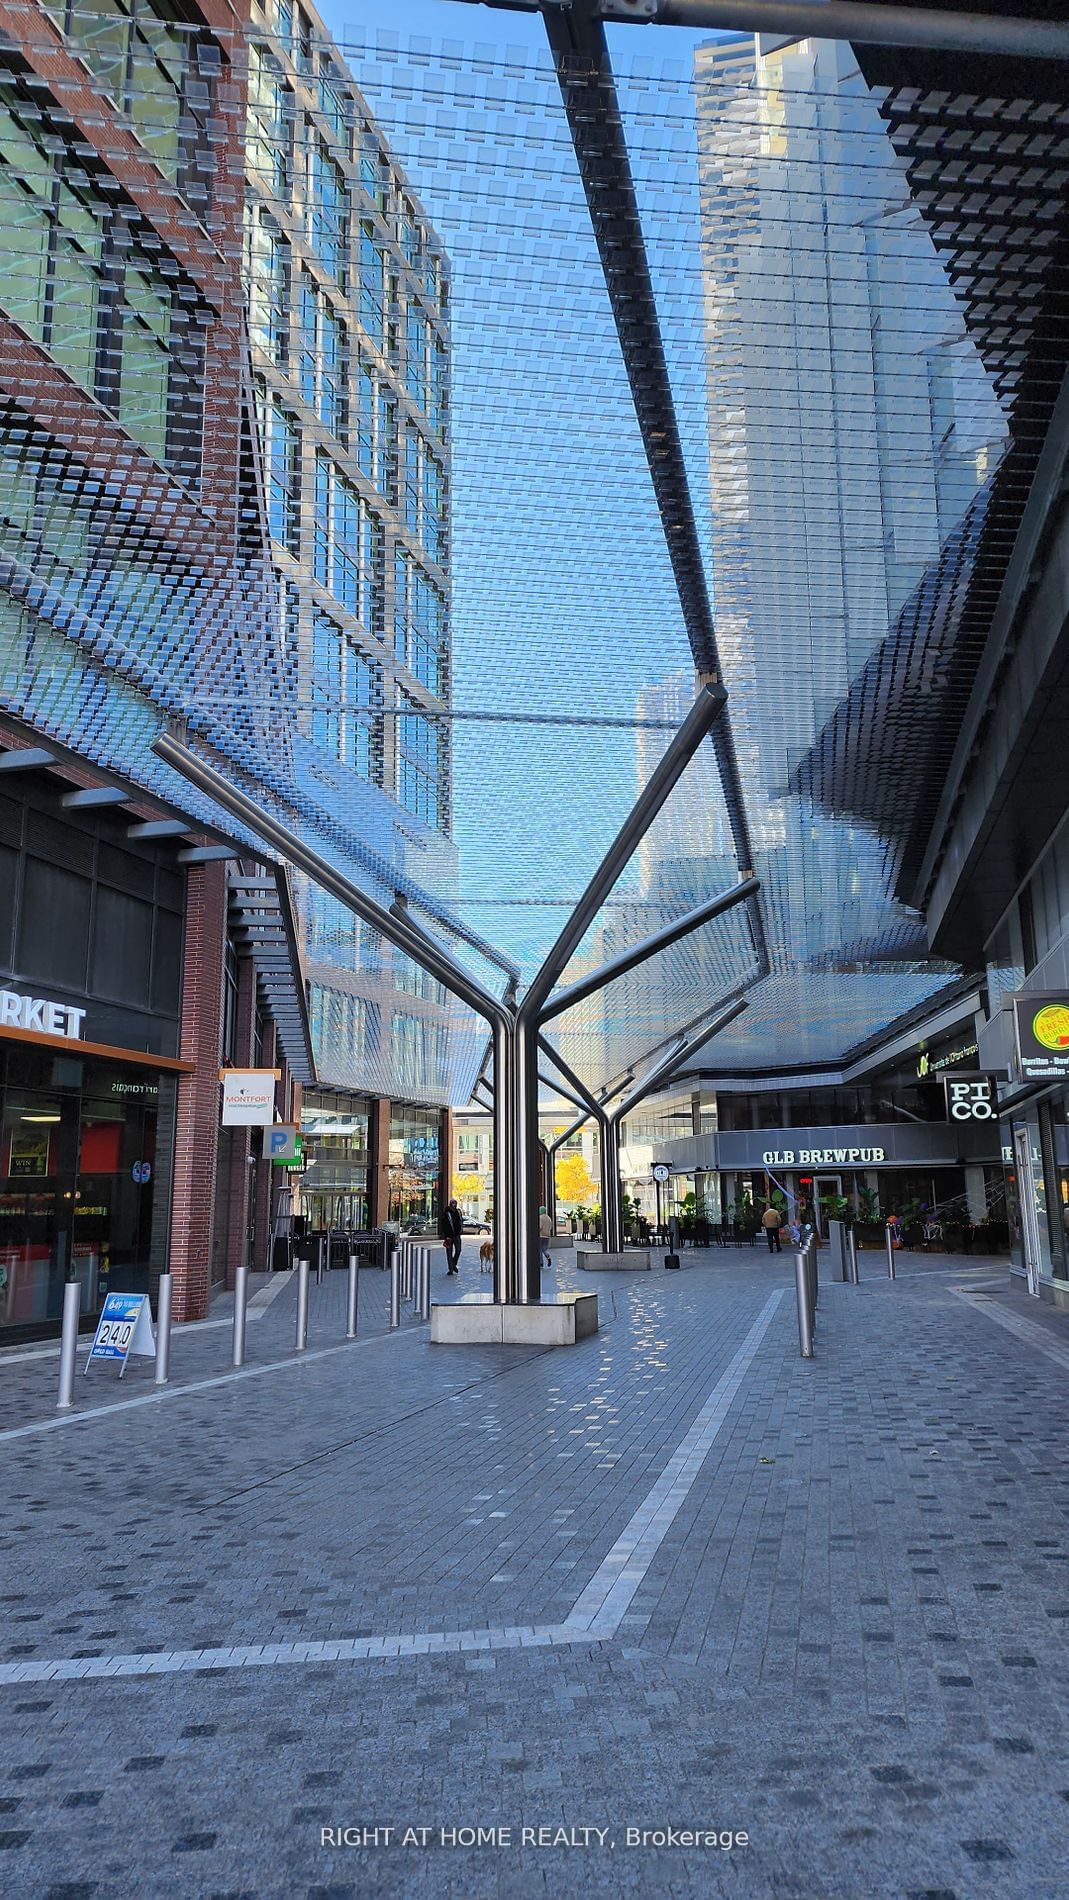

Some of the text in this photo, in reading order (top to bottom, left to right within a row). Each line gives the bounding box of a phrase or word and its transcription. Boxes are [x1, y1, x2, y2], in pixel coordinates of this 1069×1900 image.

[0, 990, 86, 1039] RKET
[950, 1083, 990, 1101] PI
[952, 1101, 997, 1119] CO.
[270, 1132, 288, 1153] P
[762, 1147, 885, 1165] GLB BREWPUB
[108, 1298, 124, 1311] 649
